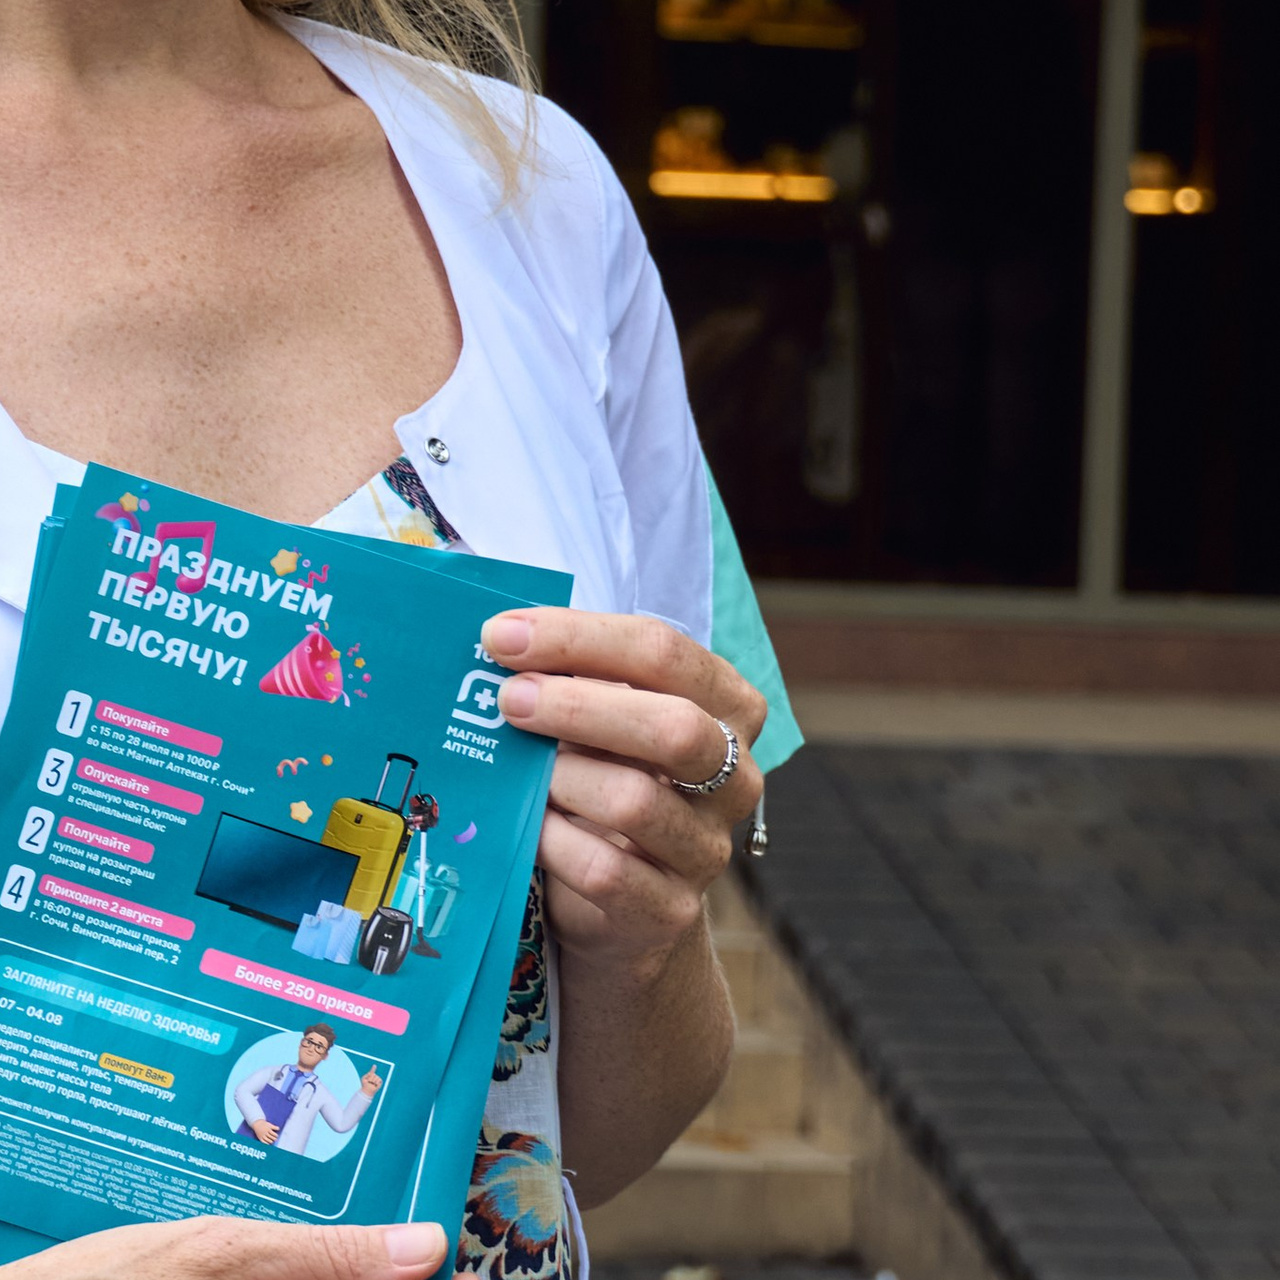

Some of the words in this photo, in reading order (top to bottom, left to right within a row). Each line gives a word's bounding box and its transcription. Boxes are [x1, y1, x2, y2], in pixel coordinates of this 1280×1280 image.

[112, 528, 333, 625] ПРАЗДНУЕМ
[99, 570, 249, 639] ПЕРВУЮ
[89, 611, 247, 686] ТЫСЯЧУ!
[69, 701, 81, 730] 1
[102, 706, 170, 737] Покупайте
[90, 724, 98, 733] с
[99, 725, 112, 737] 15
[111, 731, 126, 742] по
[126, 734, 141, 747] 28
[141, 741, 170, 756] июля
[170, 750, 185, 761] на
[442, 739, 494, 764] АПТЕКА
[446, 725, 500, 750] МАГНИТ
[45, 757, 65, 788] 3
[84, 764, 150, 795] Опускайте
[86, 737, 100, 747] во
[100, 741, 125, 756] всех
[126, 748, 166, 768] Магнит
[165, 761, 210, 783] Аптеках
[210, 777, 220, 786] г.
[67, 795, 75, 803] в
[75, 797, 143, 825] специальный
[142, 817, 167, 833] бокс
[71, 782, 122, 805] отрывную
[122, 798, 151, 814] часть
[150, 808, 187, 826] купона
[25, 816, 46, 847] 2
[63, 822, 131, 853] Получайте
[48, 853, 87, 872] призов
[87, 865, 101, 876] на
[101, 870, 133, 887] кассе
[52, 840, 85, 857] купон
[85, 851, 100, 862] на
[99, 856, 156, 880] розыгрыш
[7, 875, 26, 904] 4
[44, 880, 110, 910] Приходите
[109, 901, 120, 913] 2
[118, 906, 164, 928] августа
[29, 911, 39, 921] г.
[41, 913, 70, 931] Сочи,
[71, 923, 144, 954] Виноградный
[143, 948, 169, 963] пер.,
[170, 954, 179, 965] 2
[33, 898, 41, 907] в
[43, 900, 71, 917] 16:00
[71, 911, 86, 922] на
[85, 915, 142, 940] розыгрыш
[141, 933, 182, 954] призов,
[2, 966, 77, 999] ЗАГЛЯНИТЕ
[75, 989, 95, 1006] НА
[96, 995, 152, 1023] НЕДЕЛЮ
[152, 1013, 221, 1045] ЗДОРОВЬЯ
[234, 964, 283, 991] Более
[283, 980, 316, 1001] 250
[316, 993, 374, 1020] призов
[25, 1005, 64, 1026] 04.08
[19, 1060, 56, 1078] индекс
[56, 1071, 89, 1088] массы
[89, 1081, 113, 1096] тела
[29, 1048, 80, 1072] давление,
[81, 1064, 112, 1082] пульс,
[113, 1074, 176, 1103] температуру
[32, 1034, 99, 1062] специалисты
[103, 1057, 144, 1076] помогут
[144, 1068, 167, 1084] Вам:
[20, 1074, 57, 1094] осмотр
[56, 1086, 88, 1104] горла,
[88, 1096, 152, 1122] прослушают
[189, 1126, 228, 1149] бронхи,
[230, 1141, 267, 1160] сердце
[31, 1106, 71, 1124] получить
[70, 1118, 128, 1142] консультации
[127, 1136, 187, 1162] нутрициолога,
[187, 1155, 251, 1182] эндокринолога
[250, 1176, 259, 1184] и
[257, 1178, 313, 1203] дерматолога.
